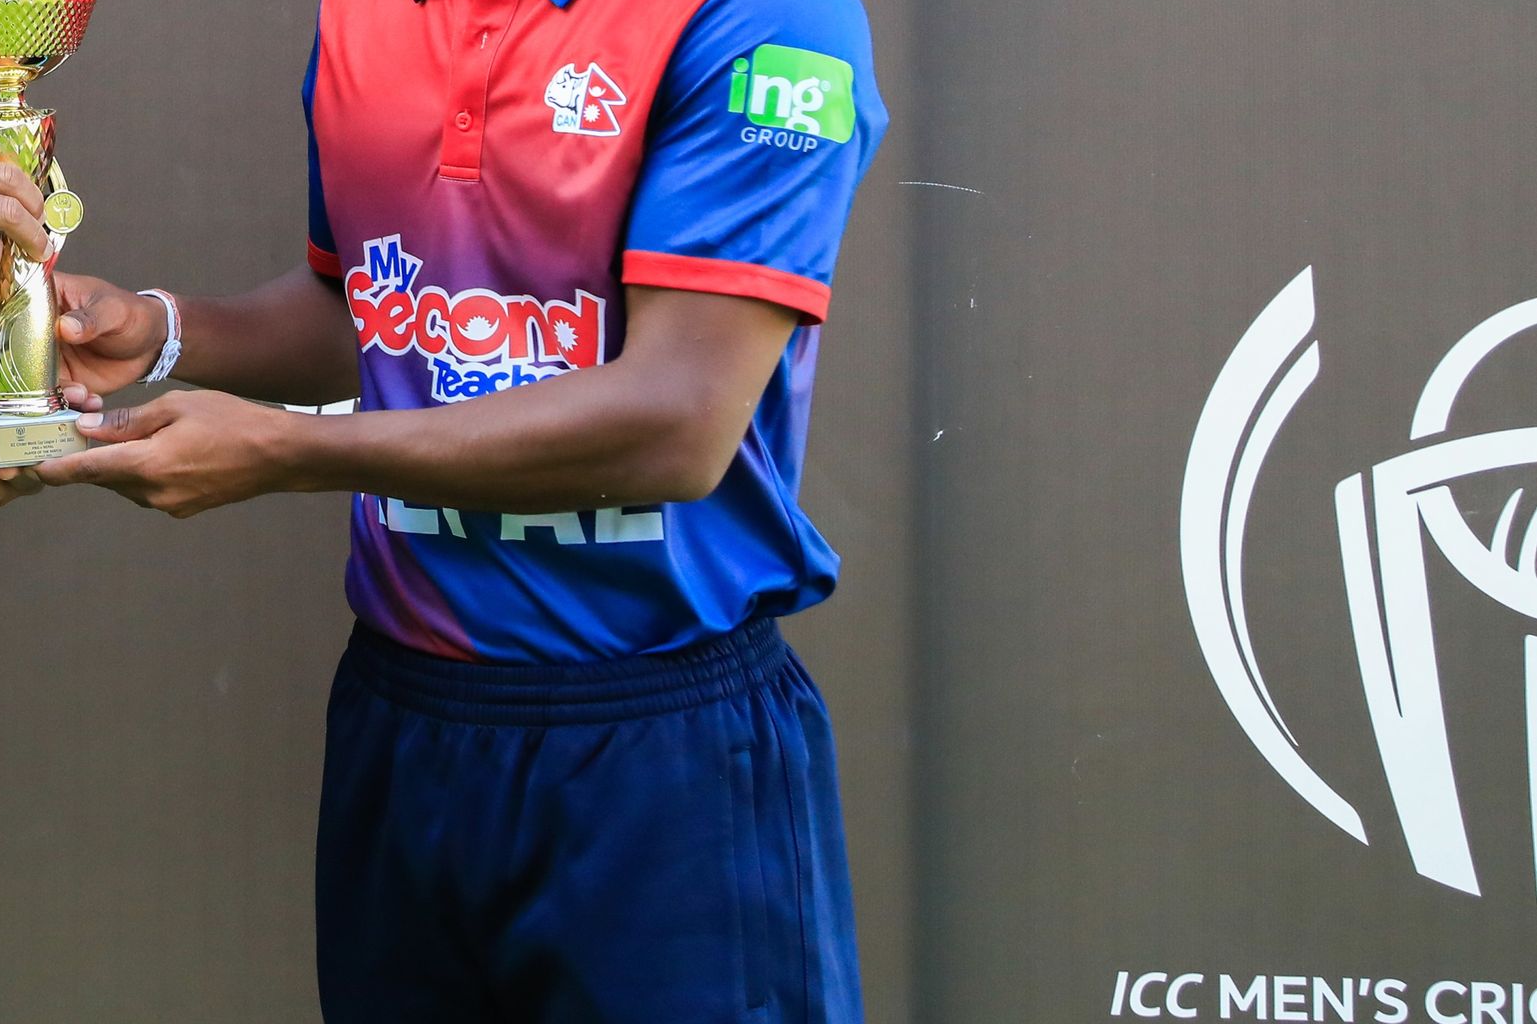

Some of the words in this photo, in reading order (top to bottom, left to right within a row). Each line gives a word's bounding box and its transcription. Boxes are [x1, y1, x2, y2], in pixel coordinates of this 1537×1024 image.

[555, 114, 576, 127] CAN
[728, 57, 825, 137] ing
[740, 126, 818, 153] GROUP
[369, 241, 417, 293] My
[347, 271, 599, 369] Second
[433, 357, 559, 398] Teach
[1110, 971, 1204, 1018] ICC
[1219, 973, 1409, 1024] MEN'S
[1424, 980, 1537, 1024] CRI
